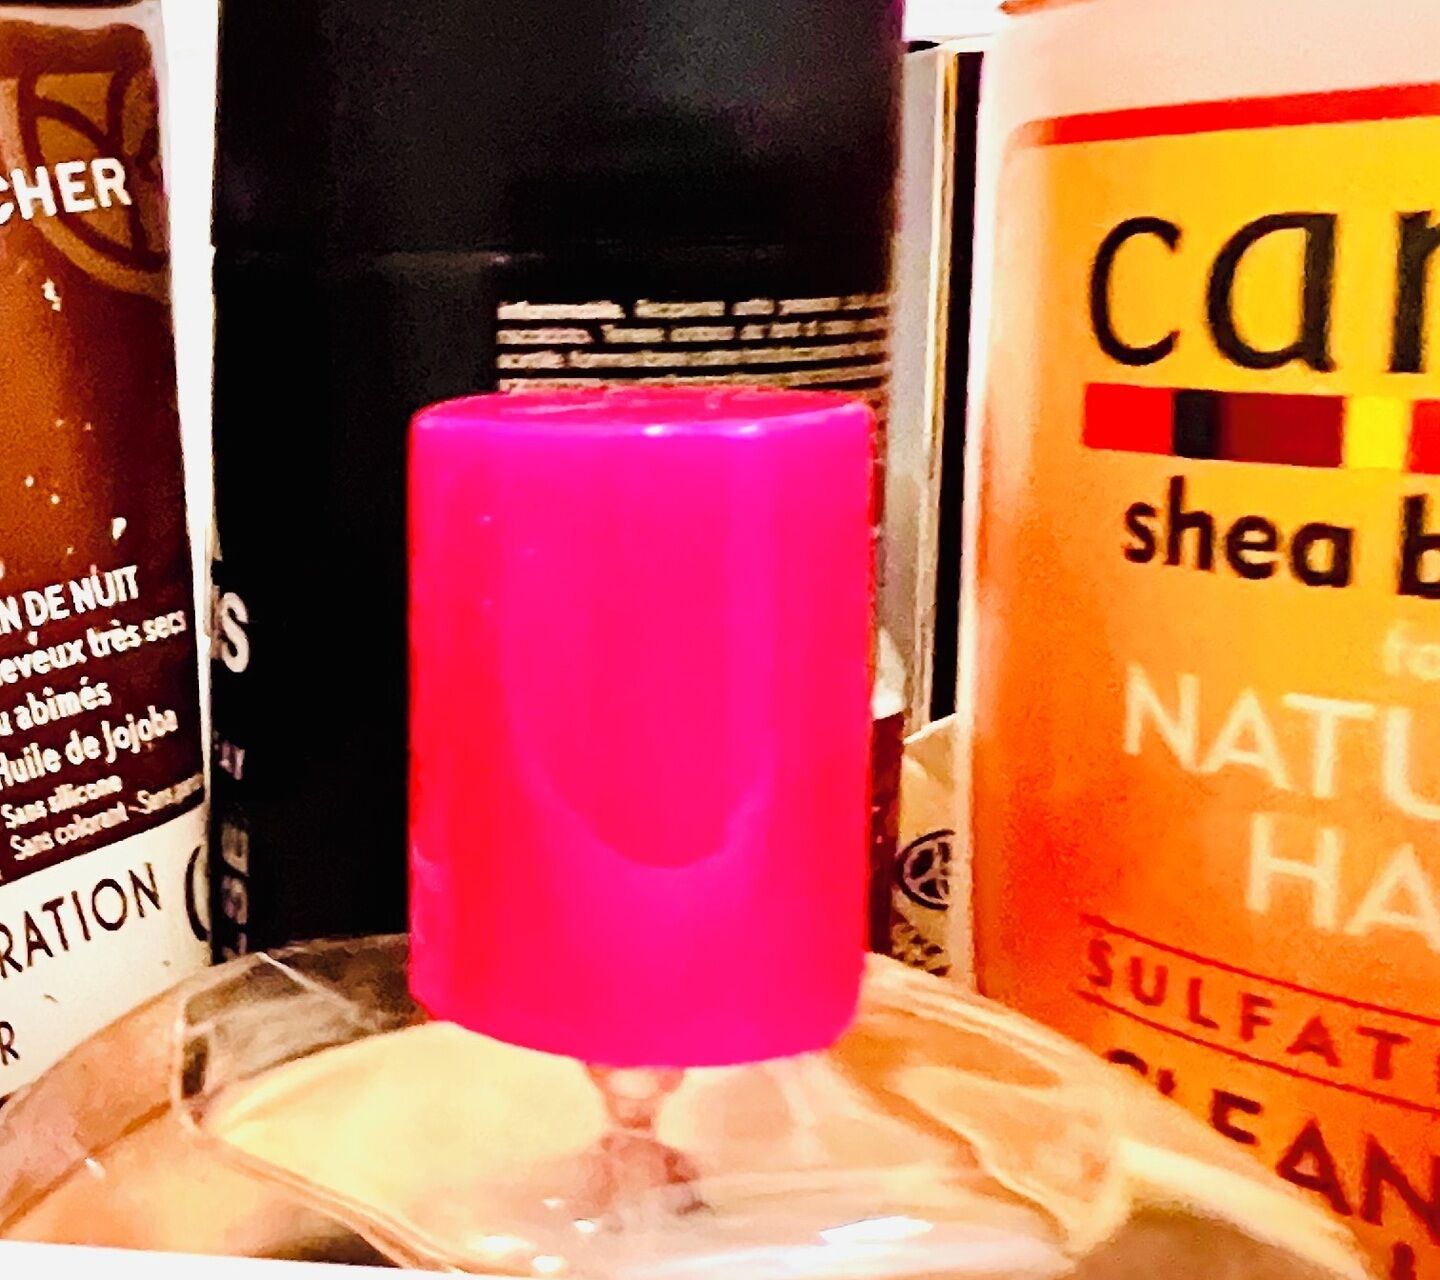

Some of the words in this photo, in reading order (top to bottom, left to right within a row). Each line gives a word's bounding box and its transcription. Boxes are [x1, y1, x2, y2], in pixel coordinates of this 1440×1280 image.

[1122, 474, 1355, 589] shea
[22, 583, 71, 627] DE
[69, 563, 140, 614] NUIT
[64, 728, 102, 766] de
[1082, 936, 1440, 1098] SULFAT
